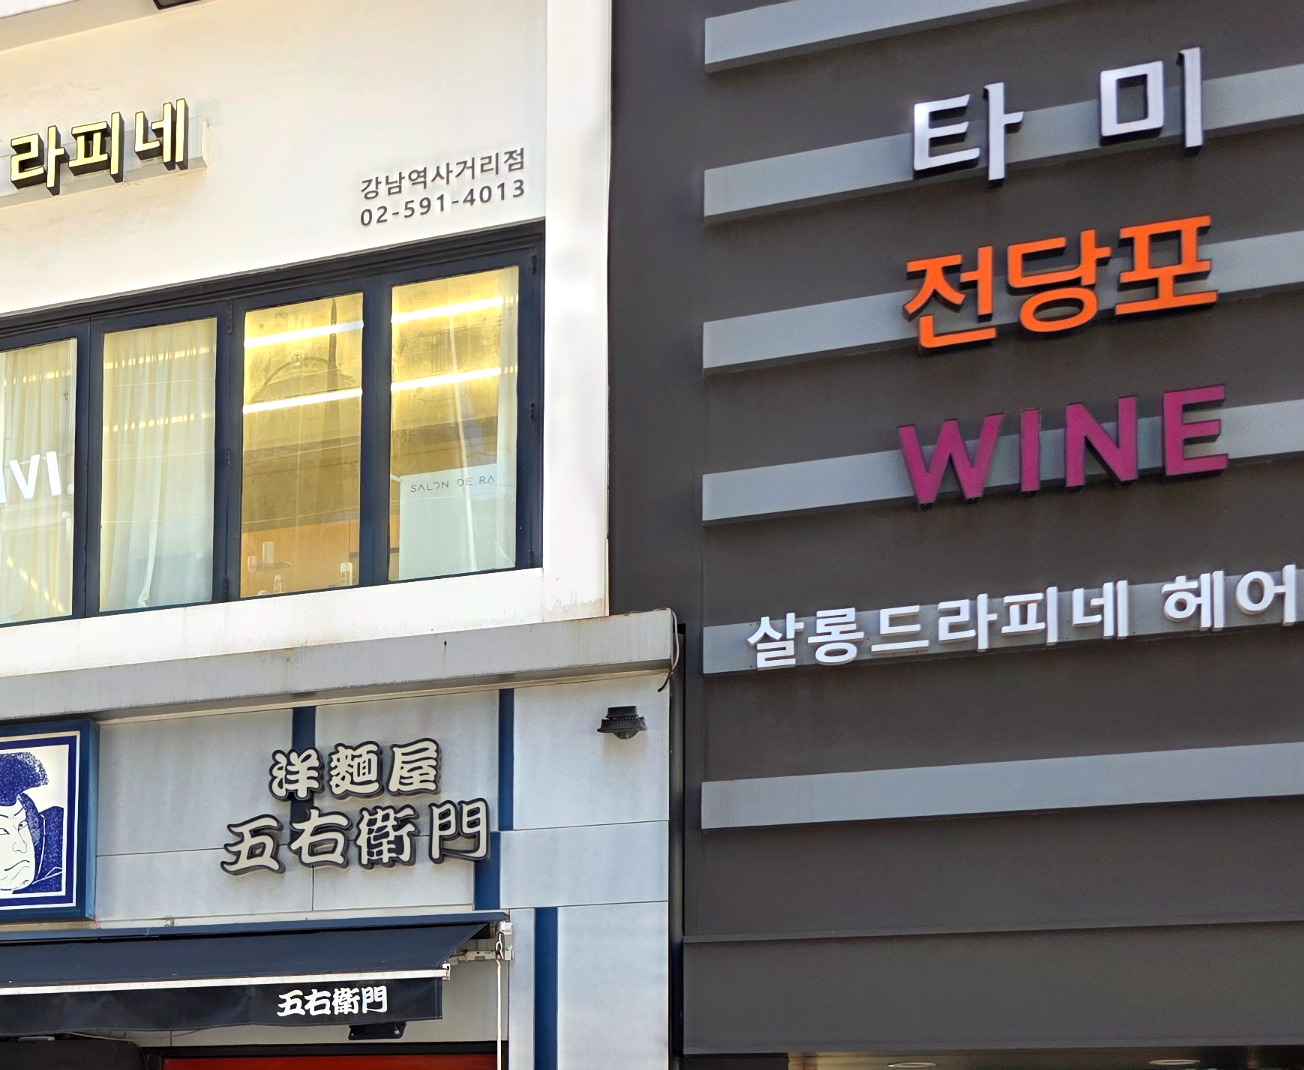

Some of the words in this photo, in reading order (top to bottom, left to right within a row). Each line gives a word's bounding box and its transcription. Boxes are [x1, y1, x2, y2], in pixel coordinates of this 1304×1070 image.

[361, 148, 525, 200] 강남역사거리점
[361, 179, 525, 226] 02-591-4013
[903, 214, 1218, 349] 전당포
[897, 384, 1229, 504] WINE
[456, 477, 472, 487] DE
[747, 579, 1129, 670] 살롱드라피네
[1160, 564, 1297, 632] 헤어
[277, 985, 388, 1017] 五右衛門
